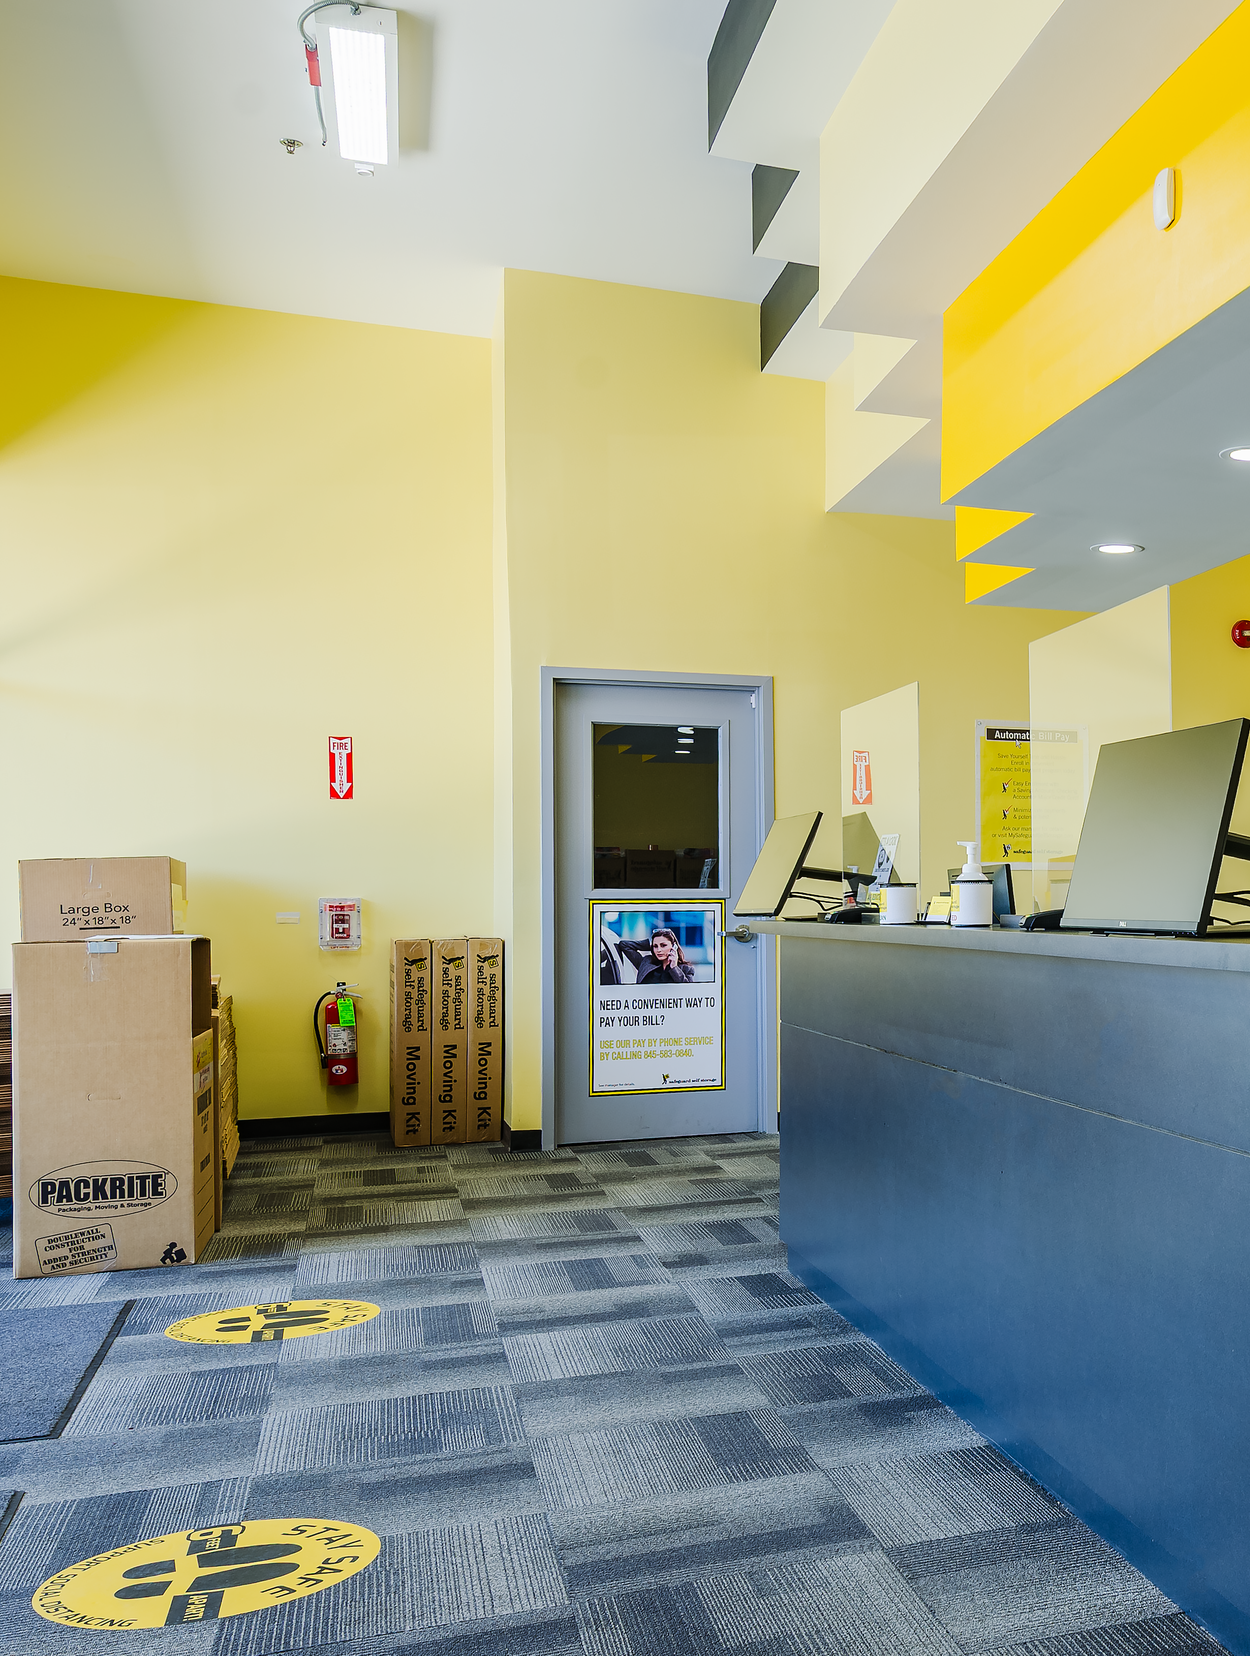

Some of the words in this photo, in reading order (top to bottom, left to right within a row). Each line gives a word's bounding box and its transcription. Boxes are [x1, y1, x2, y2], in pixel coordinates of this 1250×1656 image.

[333, 742, 348, 750] FIRE
[994, 730, 1035, 740] Automatc
[1039, 732, 1053, 740] Bill
[1055, 733, 1070, 743] Pay
[60, 904, 99, 917] Large
[104, 902, 130, 913] Box
[62, 917, 82, 927] 24"
[93, 917, 109, 926] 18"
[120, 915, 137, 925] 18"
[404, 968, 415, 990] self
[442, 967, 452, 988] self
[477, 965, 487, 986] self
[402, 991, 414, 1033] storage
[415, 976, 427, 1032] safeguard
[439, 989, 451, 1031] storage
[452, 975, 465, 1030] safeguard
[475, 987, 486, 1029] storage
[487, 973, 499, 1028] safeguard
[600, 999, 622, 1011] NEED
[624, 999, 630, 1010] A
[632, 998, 683, 1010] CONVENIENT
[685, 997, 703, 1008] WAY
[705, 997, 715, 1008] TO
[600, 1016, 616, 1028] PAY
[617, 1015, 640, 1027] YOUR
[643, 1015, 665, 1026] BILL?
[600, 1040, 614, 1049] USE
[616, 1039, 631, 1049] OUR
[632, 1039, 645, 1048] PAY
[648, 1038, 657, 1048] BY
[659, 1037, 684, 1047] PHONE
[684, 1036, 714, 1046] SERVICE
[600, 1051, 610, 1061] BY
[611, 1050, 642, 1061] CALLING
[401, 1046, 421, 1106] Moving
[439, 1044, 457, 1103] Moving
[473, 1042, 492, 1100] Moving
[405, 1112, 421, 1135] Kit
[442, 1109, 457, 1132] Kit
[477, 1106, 492, 1130] Kit
[39, 1172, 166, 1206] PACKRITE
[57, 1205, 93, 1213] Packaging,
[95, 1203, 118, 1211] Moving
[126, 1201, 152, 1209] Storage
[44, 1233, 106, 1252] CONSTRUCTION
[47, 1228, 101, 1245] DOUBLEWALL
[42, 1255, 69, 1266] ADDED
[71, 1245, 114, 1260] STRENGTH
[68, 1245, 86, 1253] FOR
[50, 1262, 67, 1271] AND
[69, 1252, 109, 1267] SECURITY
[281, 1524, 364, 1550] STAY
[72, 1538, 165, 1572] SUPPORT
[38, 1573, 77, 1601] SOCIAL
[260, 1556, 360, 1598] SAFE
[39, 1600, 138, 1627] DISTANCING
